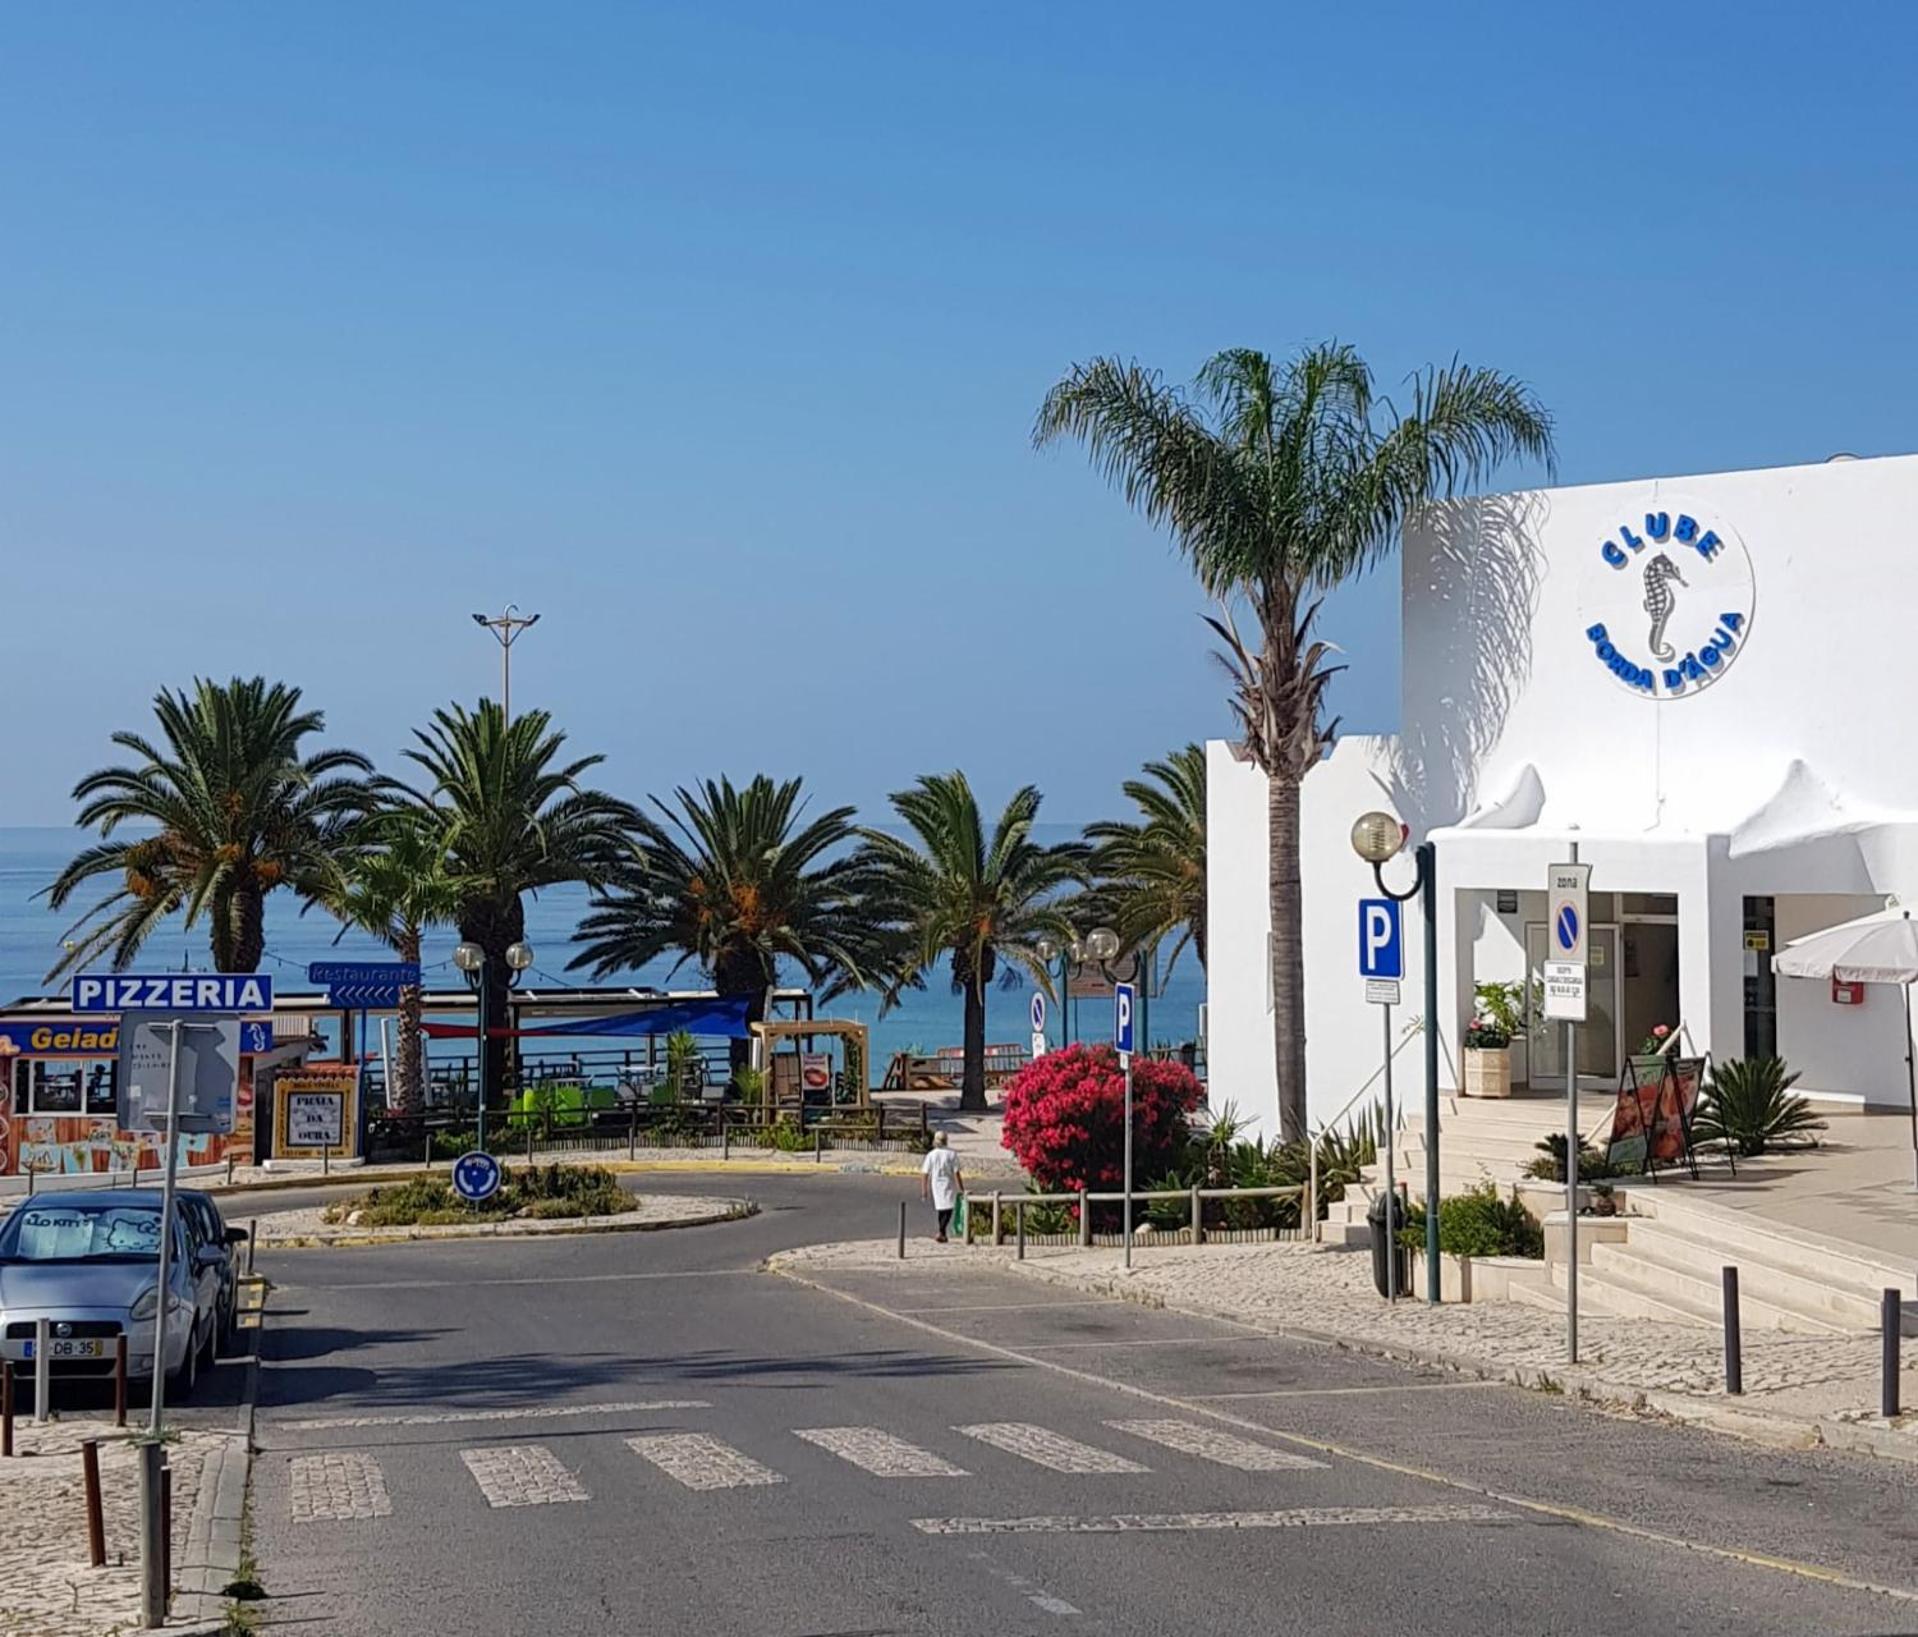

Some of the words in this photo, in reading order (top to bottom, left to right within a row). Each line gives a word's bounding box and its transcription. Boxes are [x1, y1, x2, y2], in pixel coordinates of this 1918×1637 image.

[1602, 512, 1724, 568] CLUBE
[1586, 622, 1656, 694] BORDA
[1366, 906, 1391, 970] P
[312, 964, 416, 980] Restaurante
[79, 979, 265, 1007] PIZZERIA
[1118, 993, 1130, 1043] P
[31, 1027, 120, 1050] Gelad
[297, 1097, 334, 1106] PRAIA
[306, 1114, 323, 1123] DA
[298, 1131, 331, 1140] OURA
